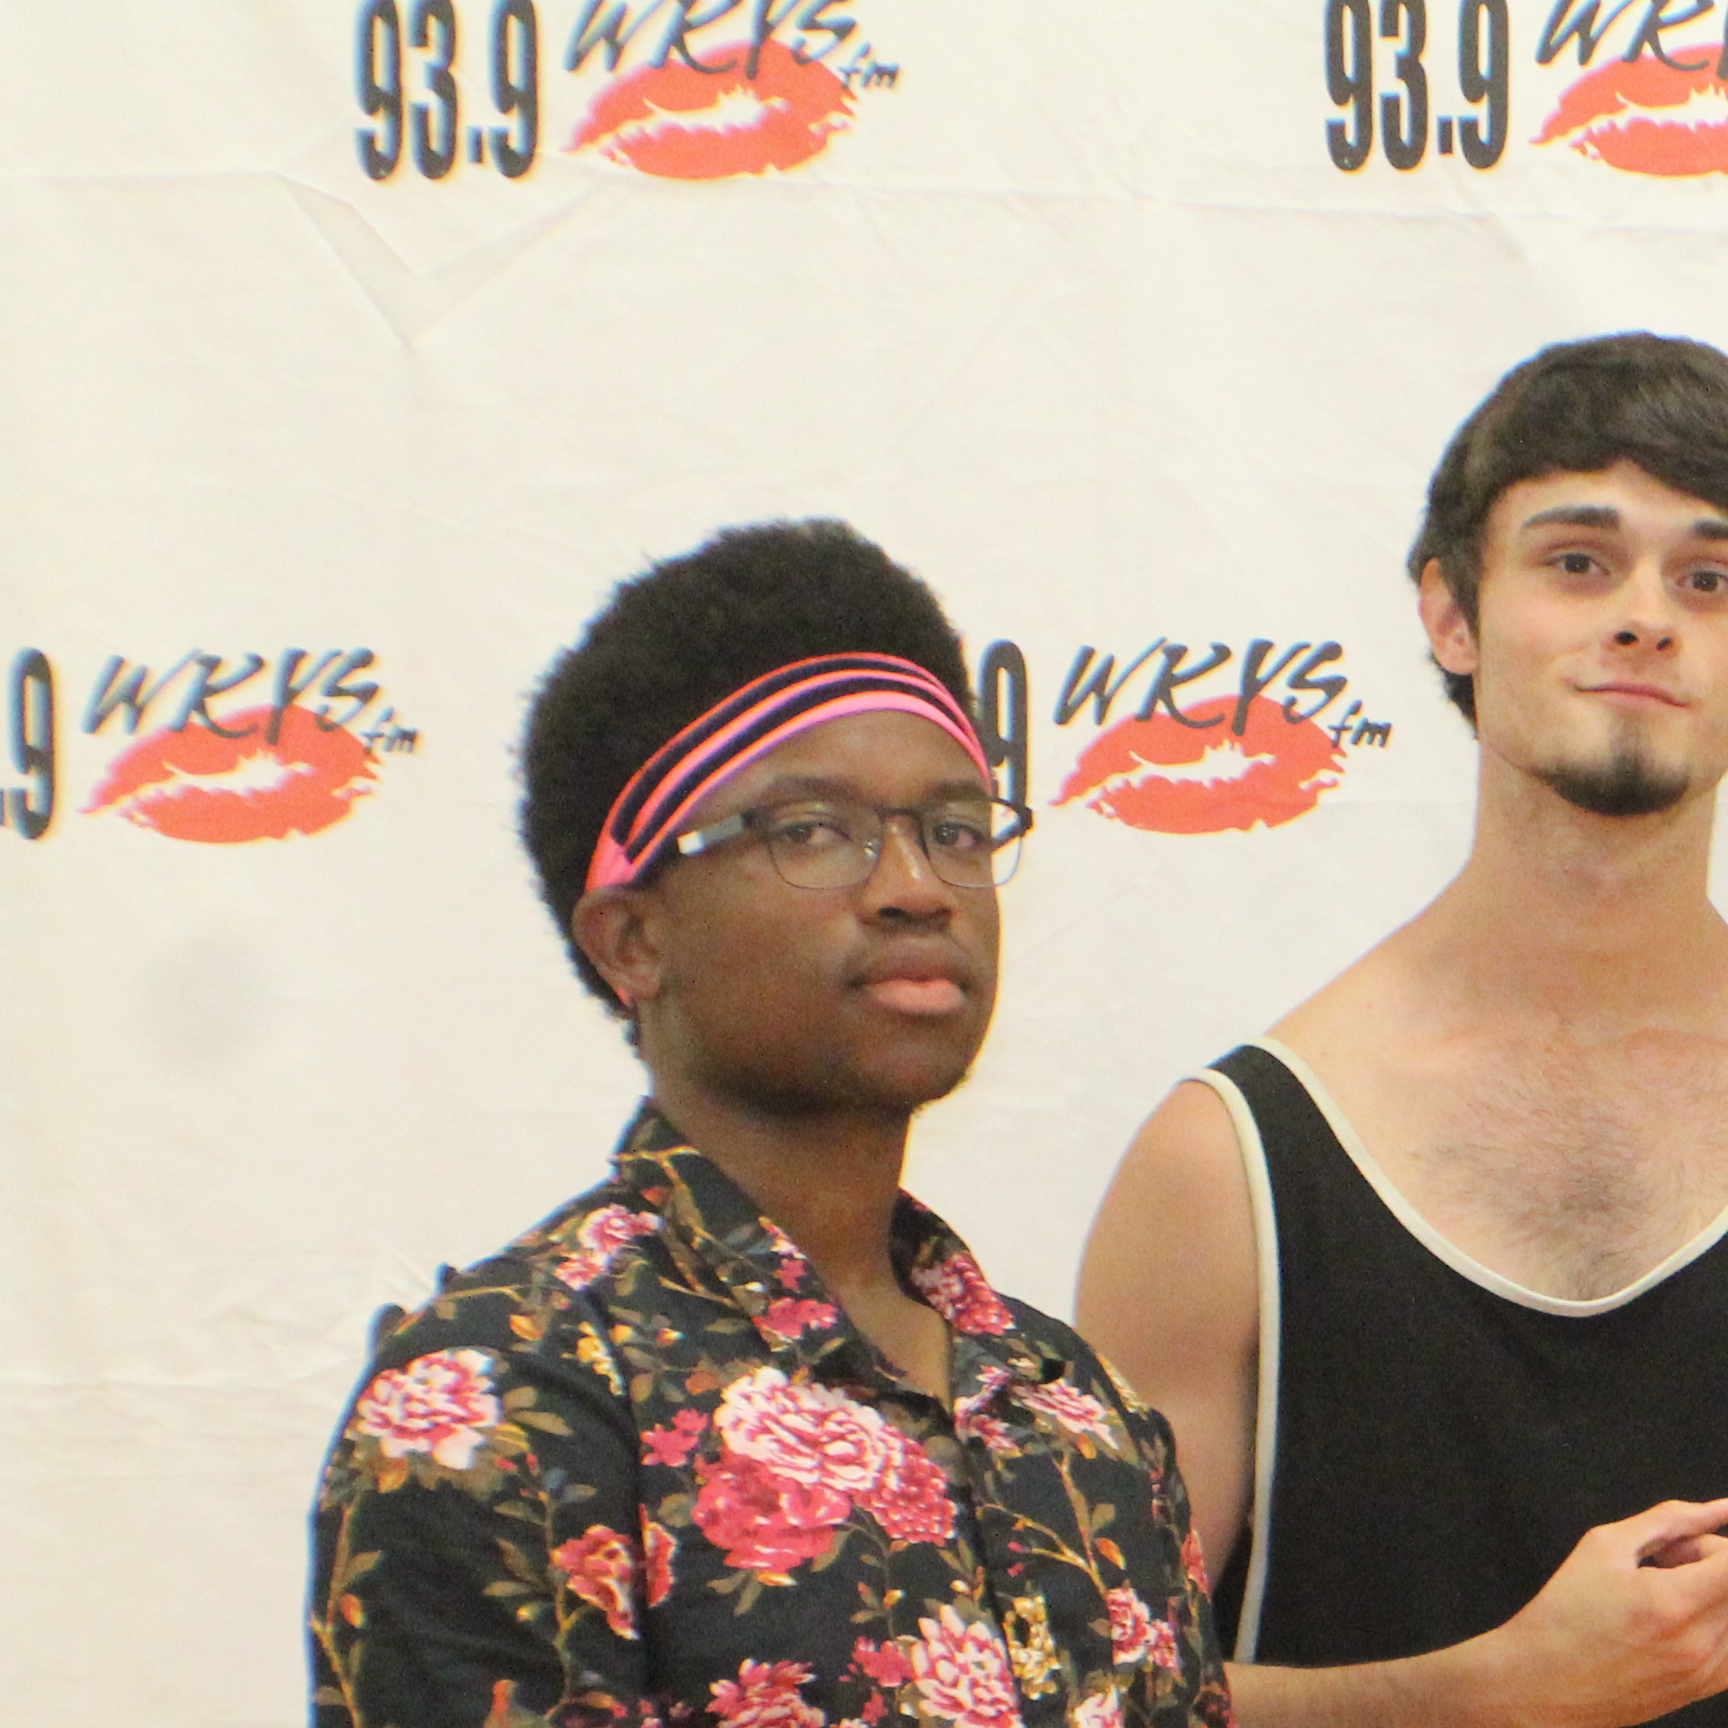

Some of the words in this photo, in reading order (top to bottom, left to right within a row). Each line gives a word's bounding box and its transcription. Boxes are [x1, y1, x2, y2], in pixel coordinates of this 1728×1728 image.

[355, 0, 539, 180] 93.9
[563, 0, 856, 80] WKYS
[1323, 0, 1509, 171] 93.9
[83, 648, 379, 746] WKYS
[1054, 637, 1348, 737] WKYS
